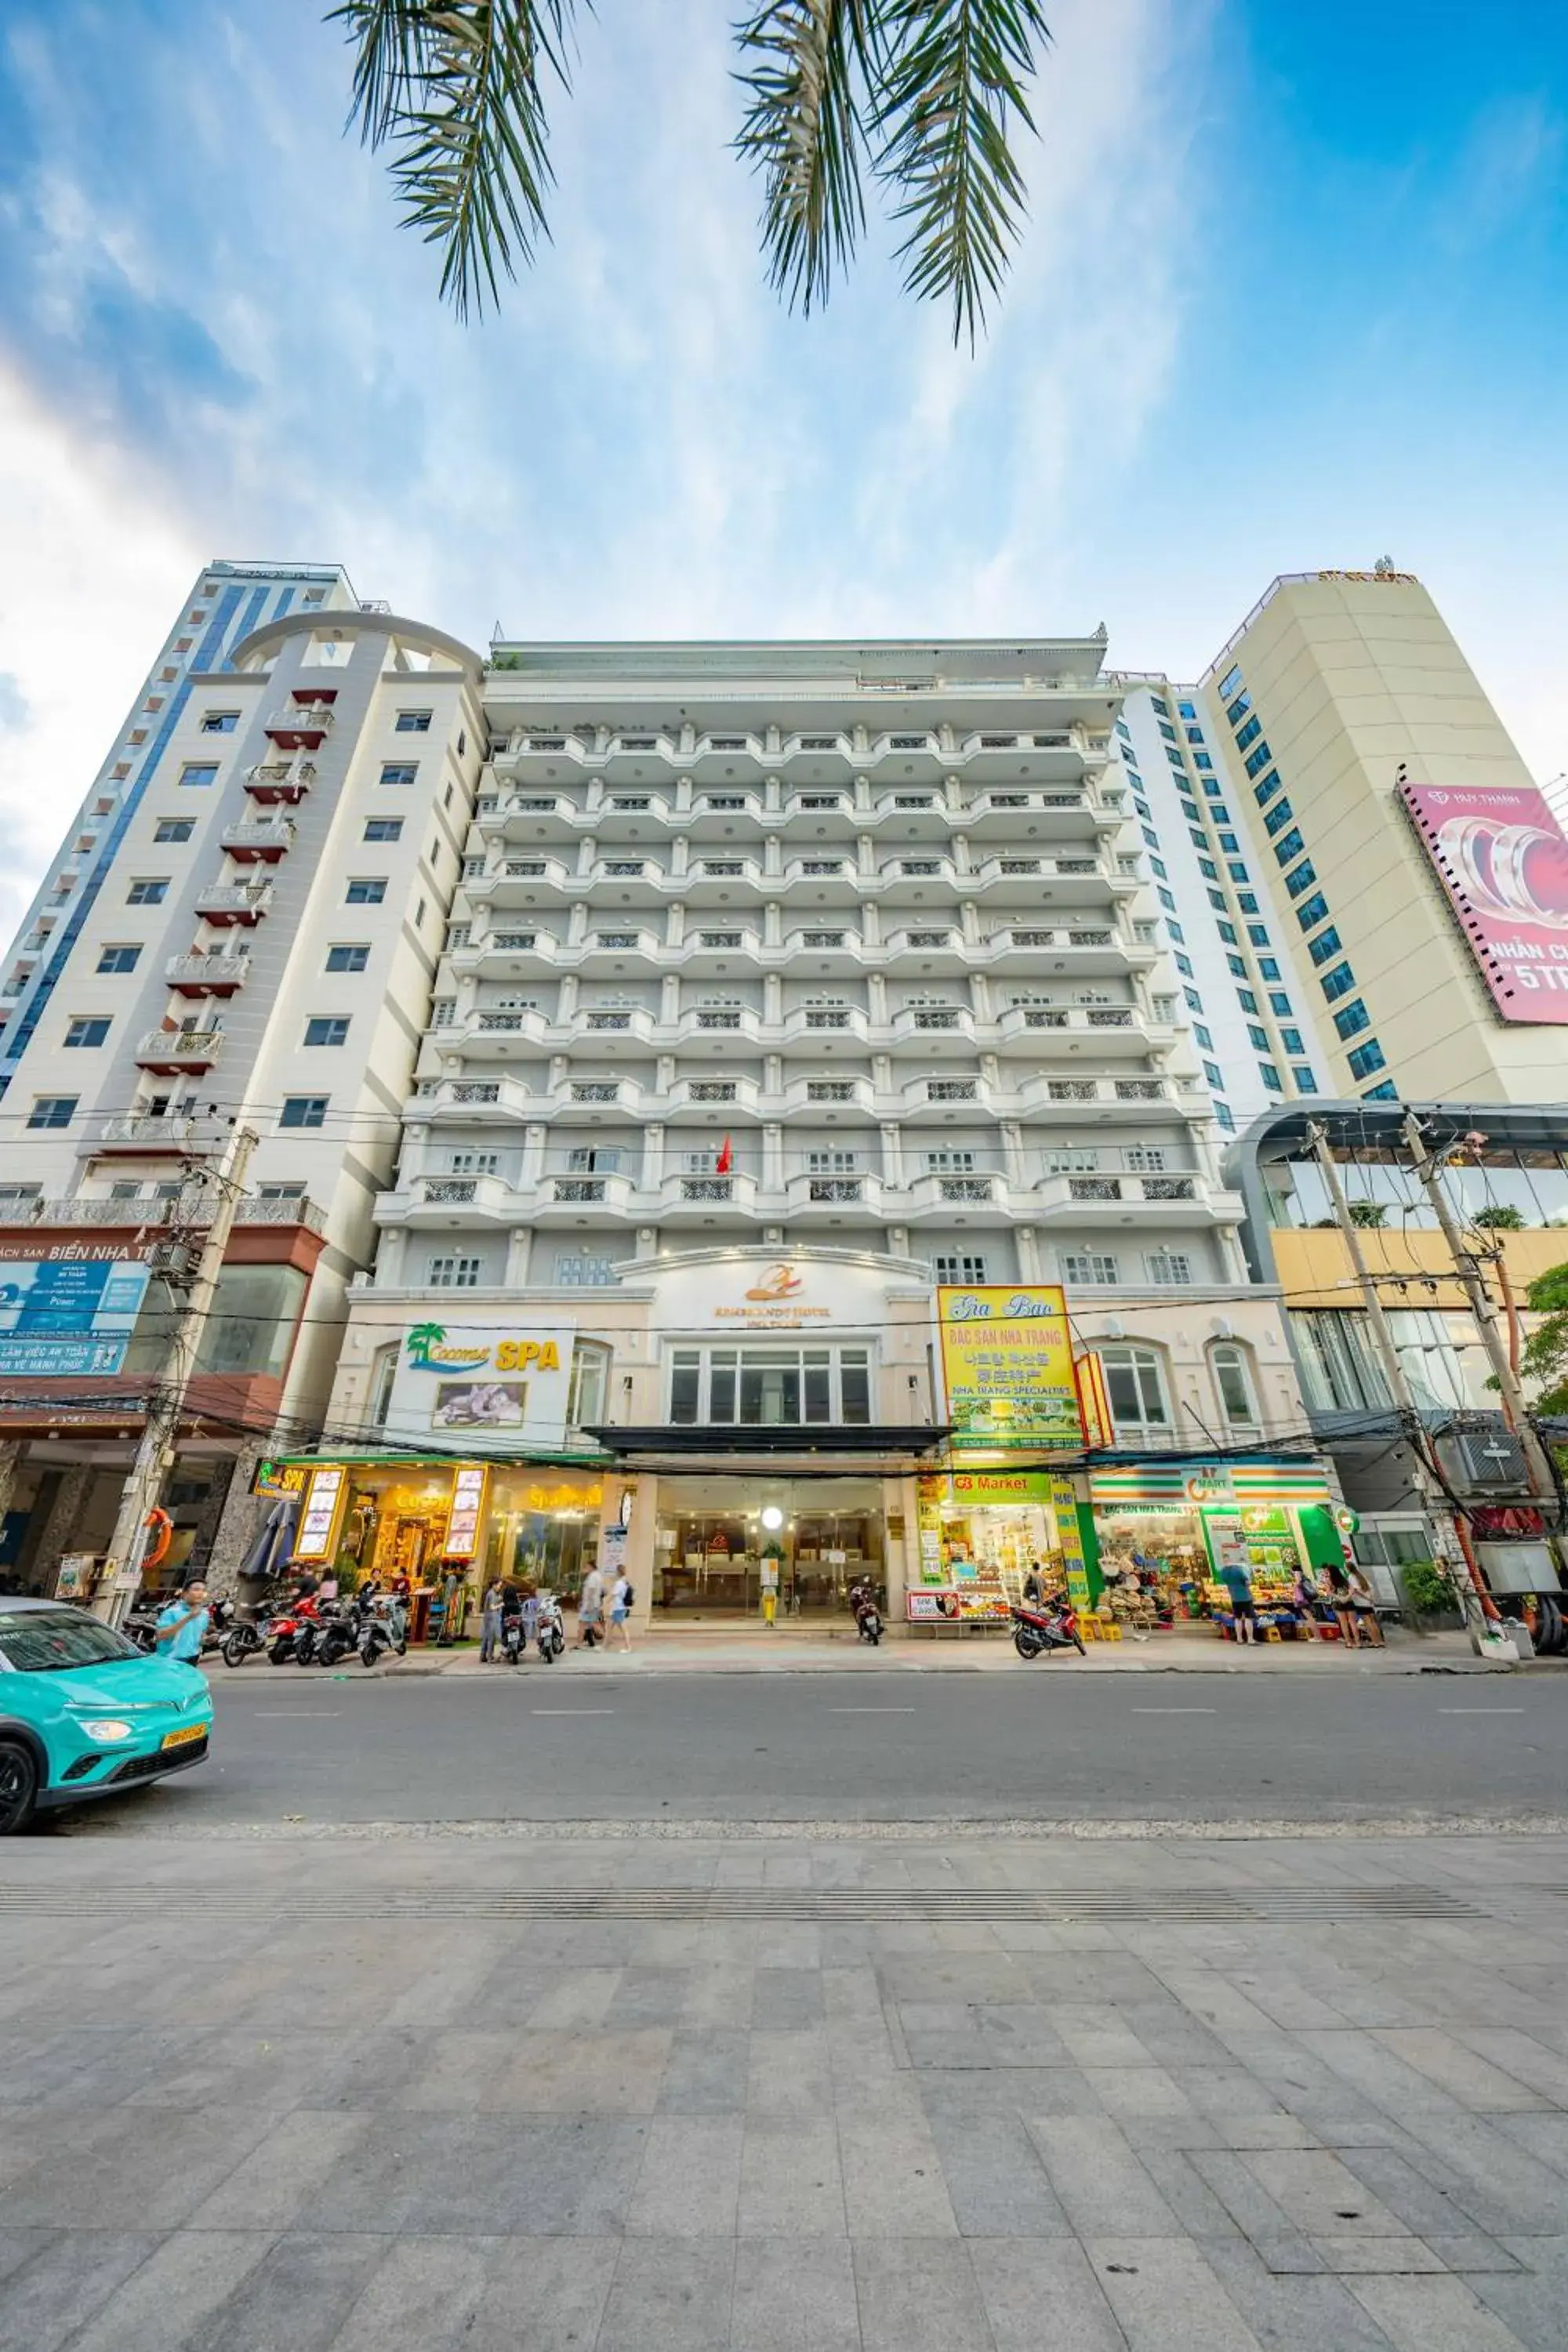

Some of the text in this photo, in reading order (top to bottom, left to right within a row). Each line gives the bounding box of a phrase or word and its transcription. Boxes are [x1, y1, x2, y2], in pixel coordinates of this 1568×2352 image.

[92, 1246, 129, 1260] NHA
[1025, 1330, 1062, 1345] TRANG
[495, 1341, 560, 1371] SPA
[977, 1476, 1028, 1490] Market
